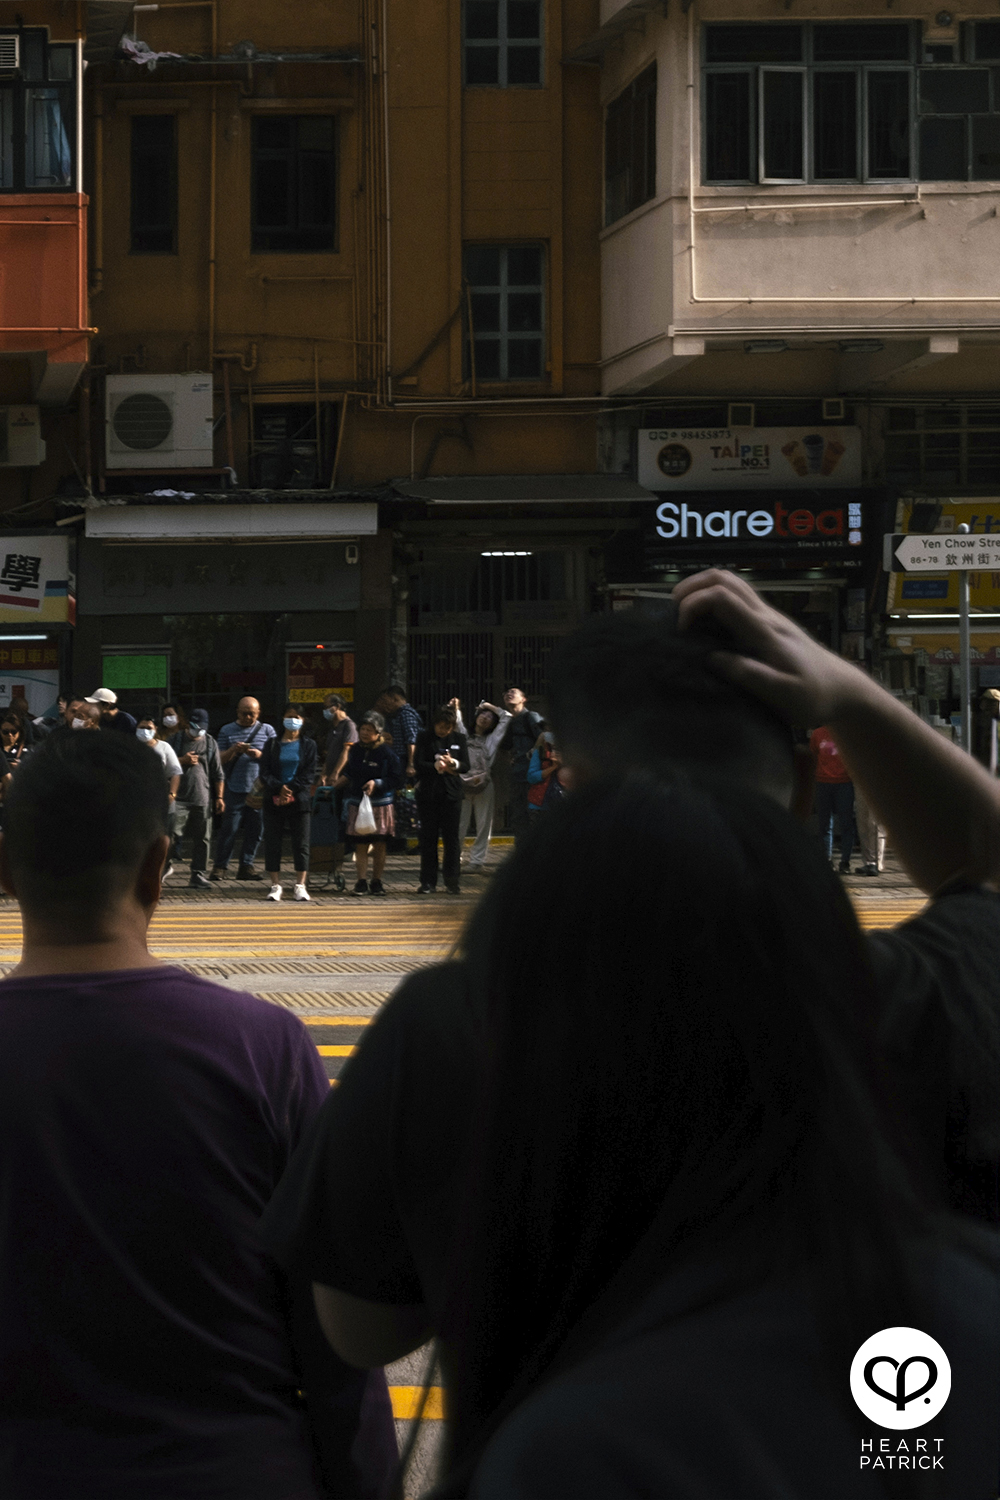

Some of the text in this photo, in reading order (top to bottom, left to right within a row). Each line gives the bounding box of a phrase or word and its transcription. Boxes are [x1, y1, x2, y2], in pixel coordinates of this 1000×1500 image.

[741, 457, 770, 467] NO.1
[655, 501, 844, 539] Sharetea
[922, 539, 941, 548] Yen
[945, 538, 975, 548] Chow
[945, 553, 990, 566] 欽州街
[0, 553, 41, 592] 學
